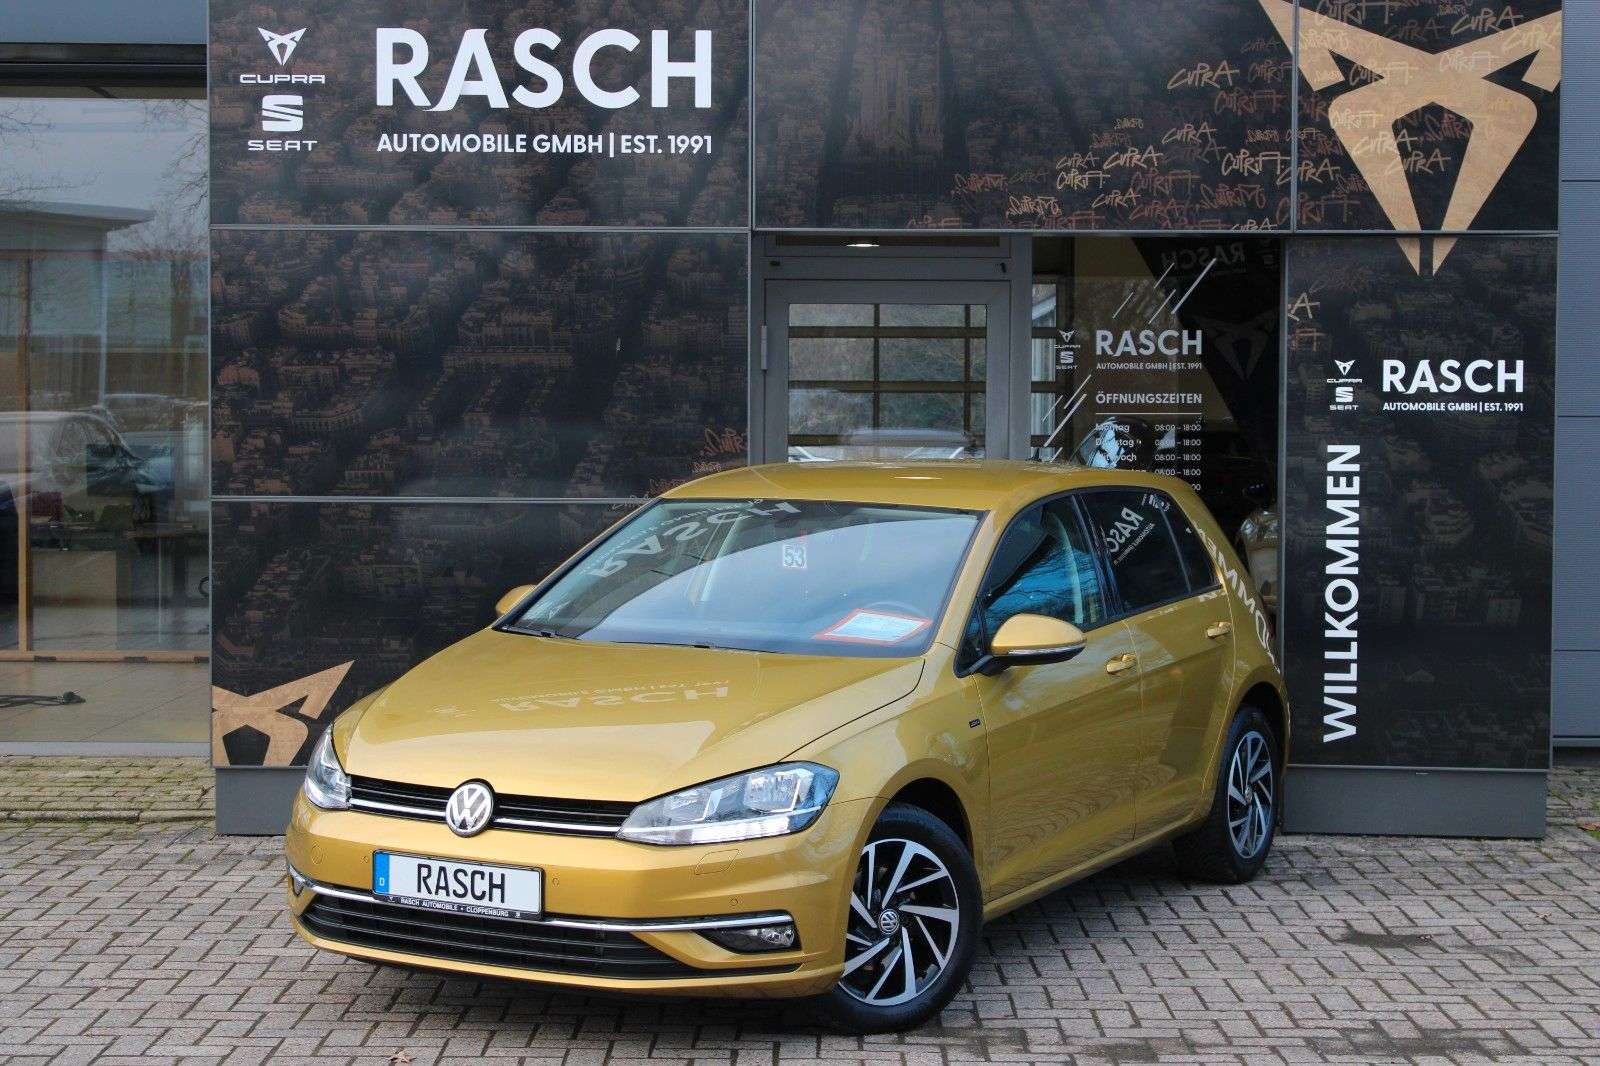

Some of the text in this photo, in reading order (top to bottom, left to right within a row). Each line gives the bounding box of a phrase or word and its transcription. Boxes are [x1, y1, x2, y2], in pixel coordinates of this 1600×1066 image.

[240, 74, 325, 84] CUPRA
[376, 28, 712, 111] RASCH
[1166, 60, 1240, 90] CUPRA
[248, 140, 318, 151] SEAT
[377, 134, 712, 153] AUTOMOBILE GMBH EST. 1991
[1103, 145, 1164, 170] CUPRA
[1096, 330, 1202, 357] RASCH
[1382, 359, 1524, 394] RASCH
[1096, 391, 1202, 404] ÖFFNUNGSZEITEN
[1382, 402, 1524, 412] AUTOMOBILE GMBH EST. 1991
[1183, 439, 1202, 447] 18:00
[1183, 468, 1202, 476] 18:00
[1322, 444, 1361, 743] WILLKOMMEN
[416, 863, 506, 904] RASCH
[400, 896, 509, 918] RASCH AUTOMOBILE CLOPPENBURG
